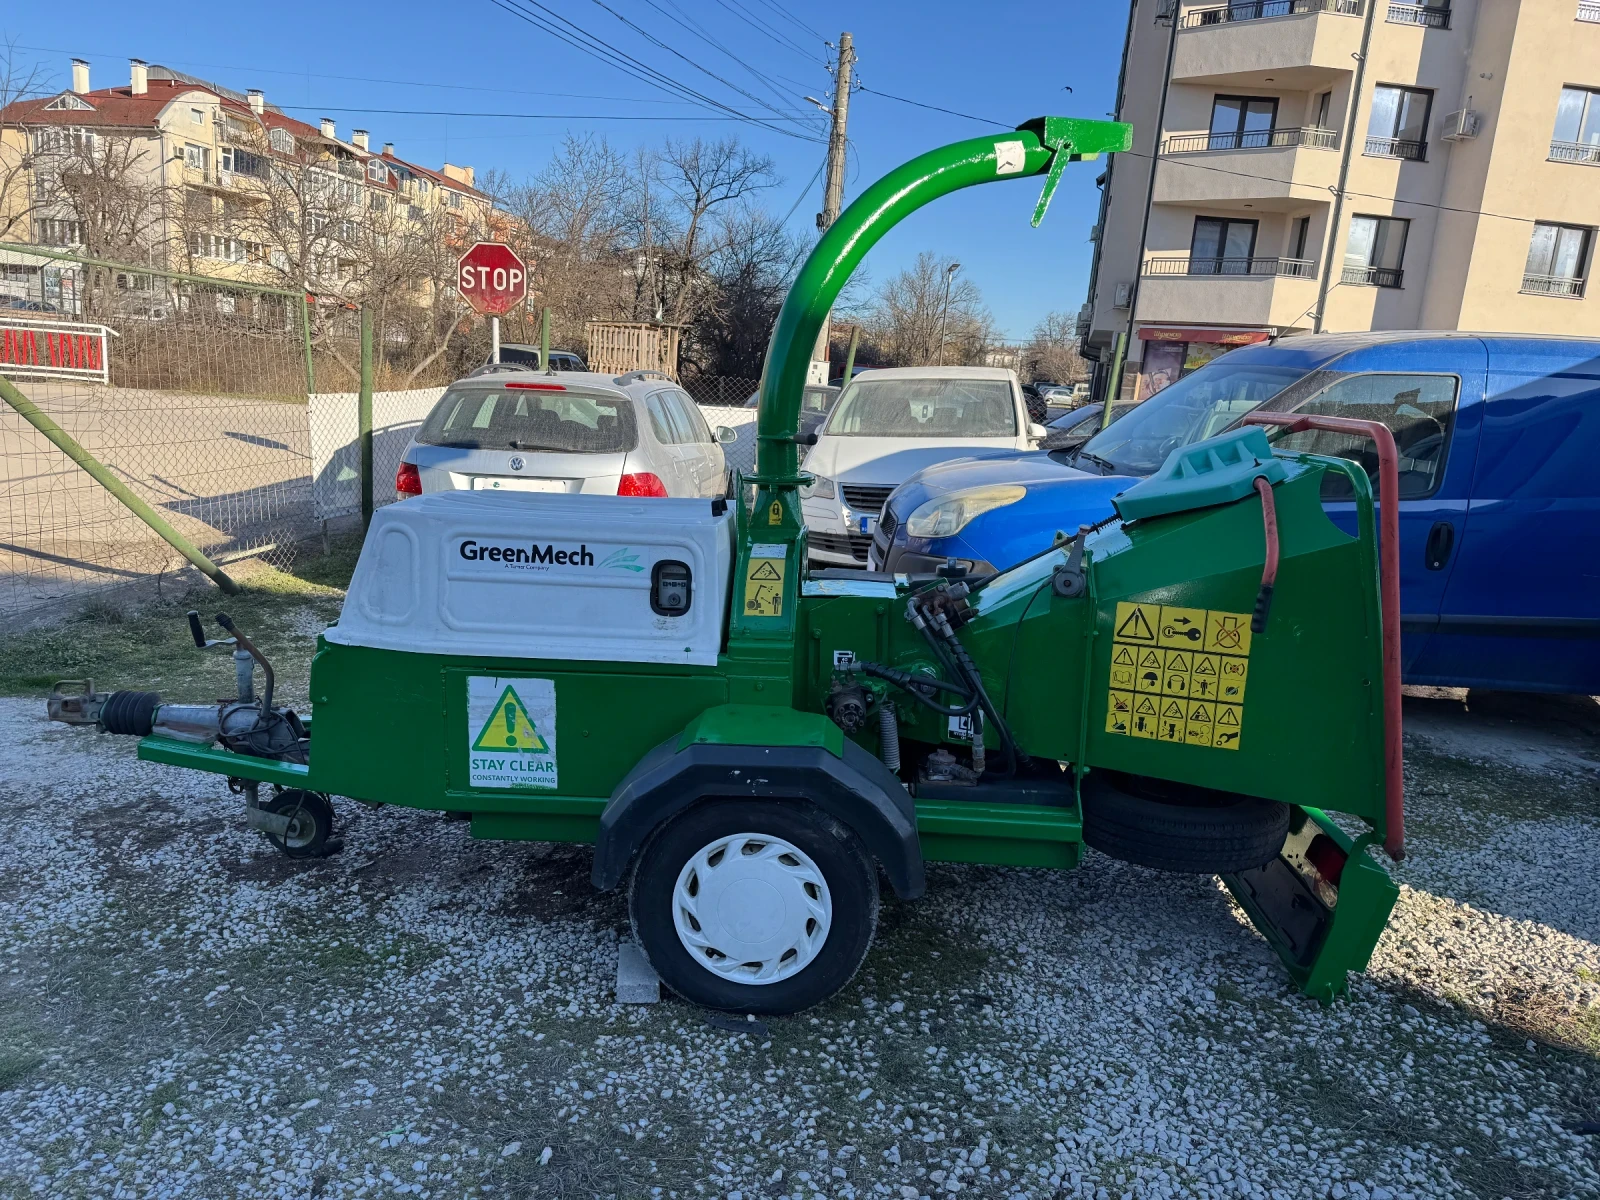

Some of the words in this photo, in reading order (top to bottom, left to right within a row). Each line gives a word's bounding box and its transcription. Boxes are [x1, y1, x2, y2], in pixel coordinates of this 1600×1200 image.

[461, 265, 523, 292] STOP
[459, 540, 594, 567] GreenMech
[525, 564, 550, 572] Company
[472, 759, 505, 770] STAY
[509, 760, 555, 773] CLEAR
[472, 774, 519, 782] CONSTANTLY
[520, 776, 556, 784] WORKING
